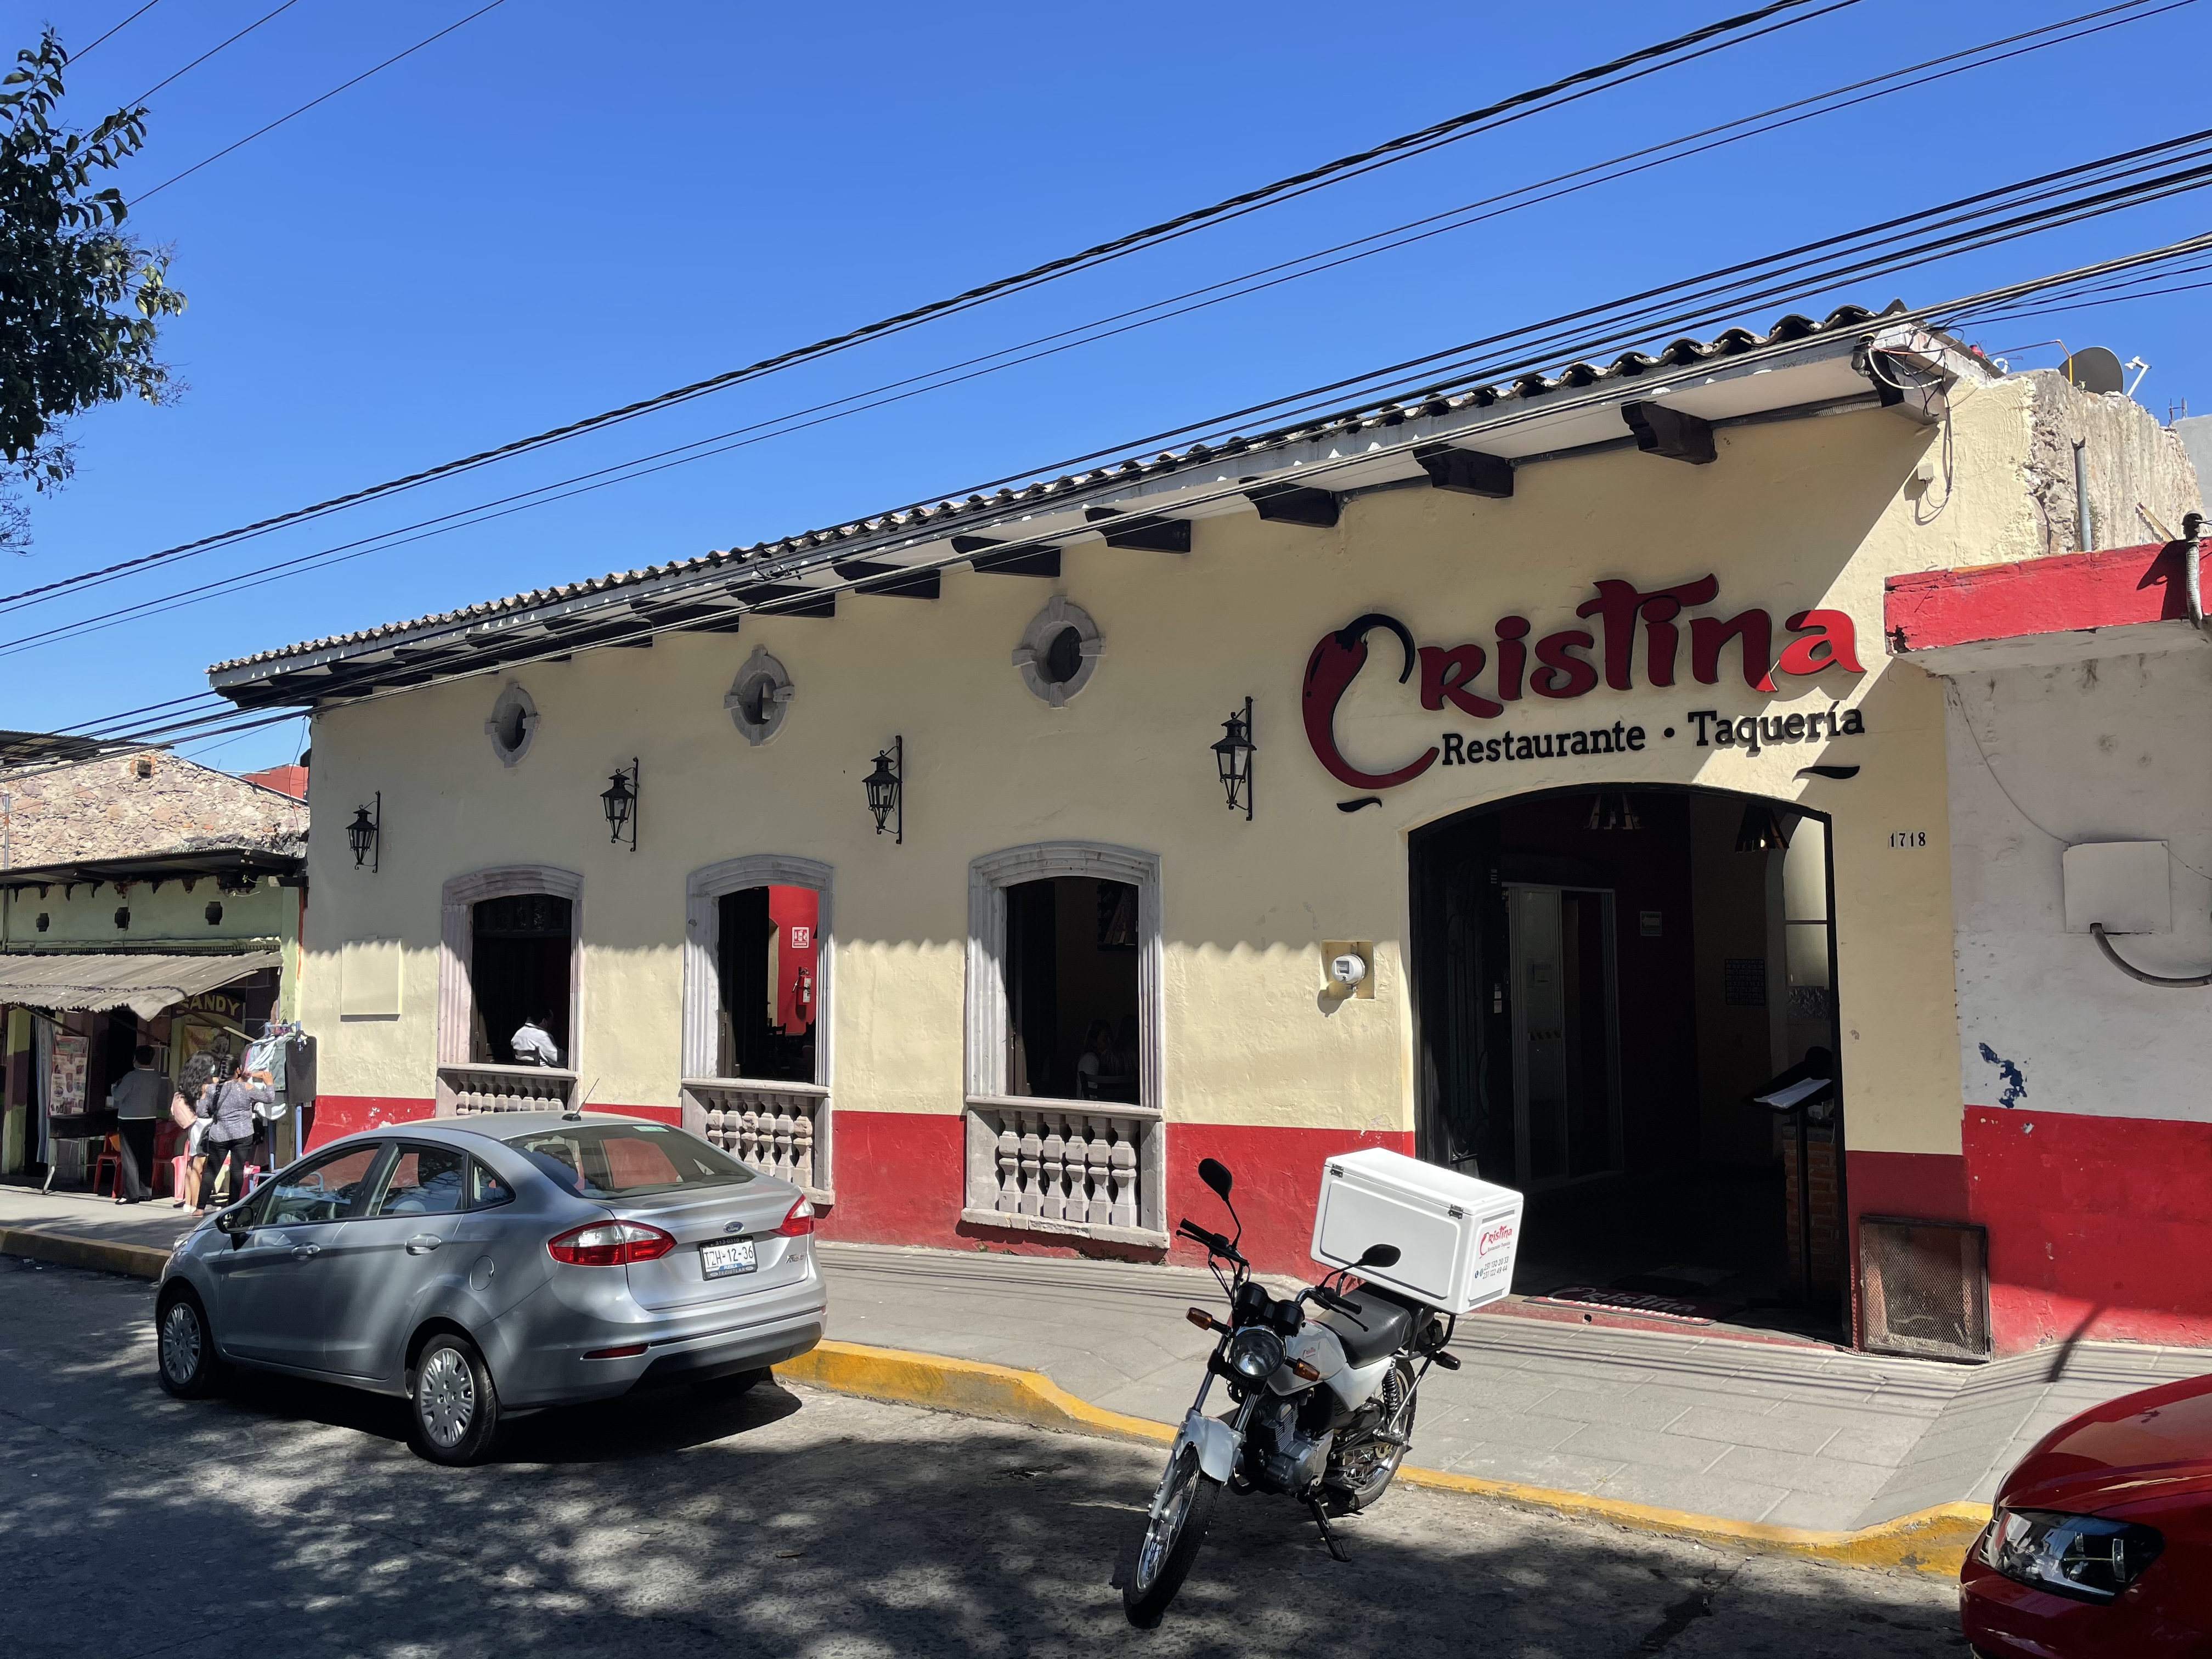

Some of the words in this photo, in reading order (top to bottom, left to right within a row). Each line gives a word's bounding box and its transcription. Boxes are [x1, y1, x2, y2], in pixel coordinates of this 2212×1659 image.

[1302, 573, 1864, 789] Cristina
[1442, 720, 1646, 765] Restaurante
[1688, 701, 1865, 753] Taquería
[1889, 832, 1926, 848] 1718
[704, 1245, 754, 1266] TZH-12-36
